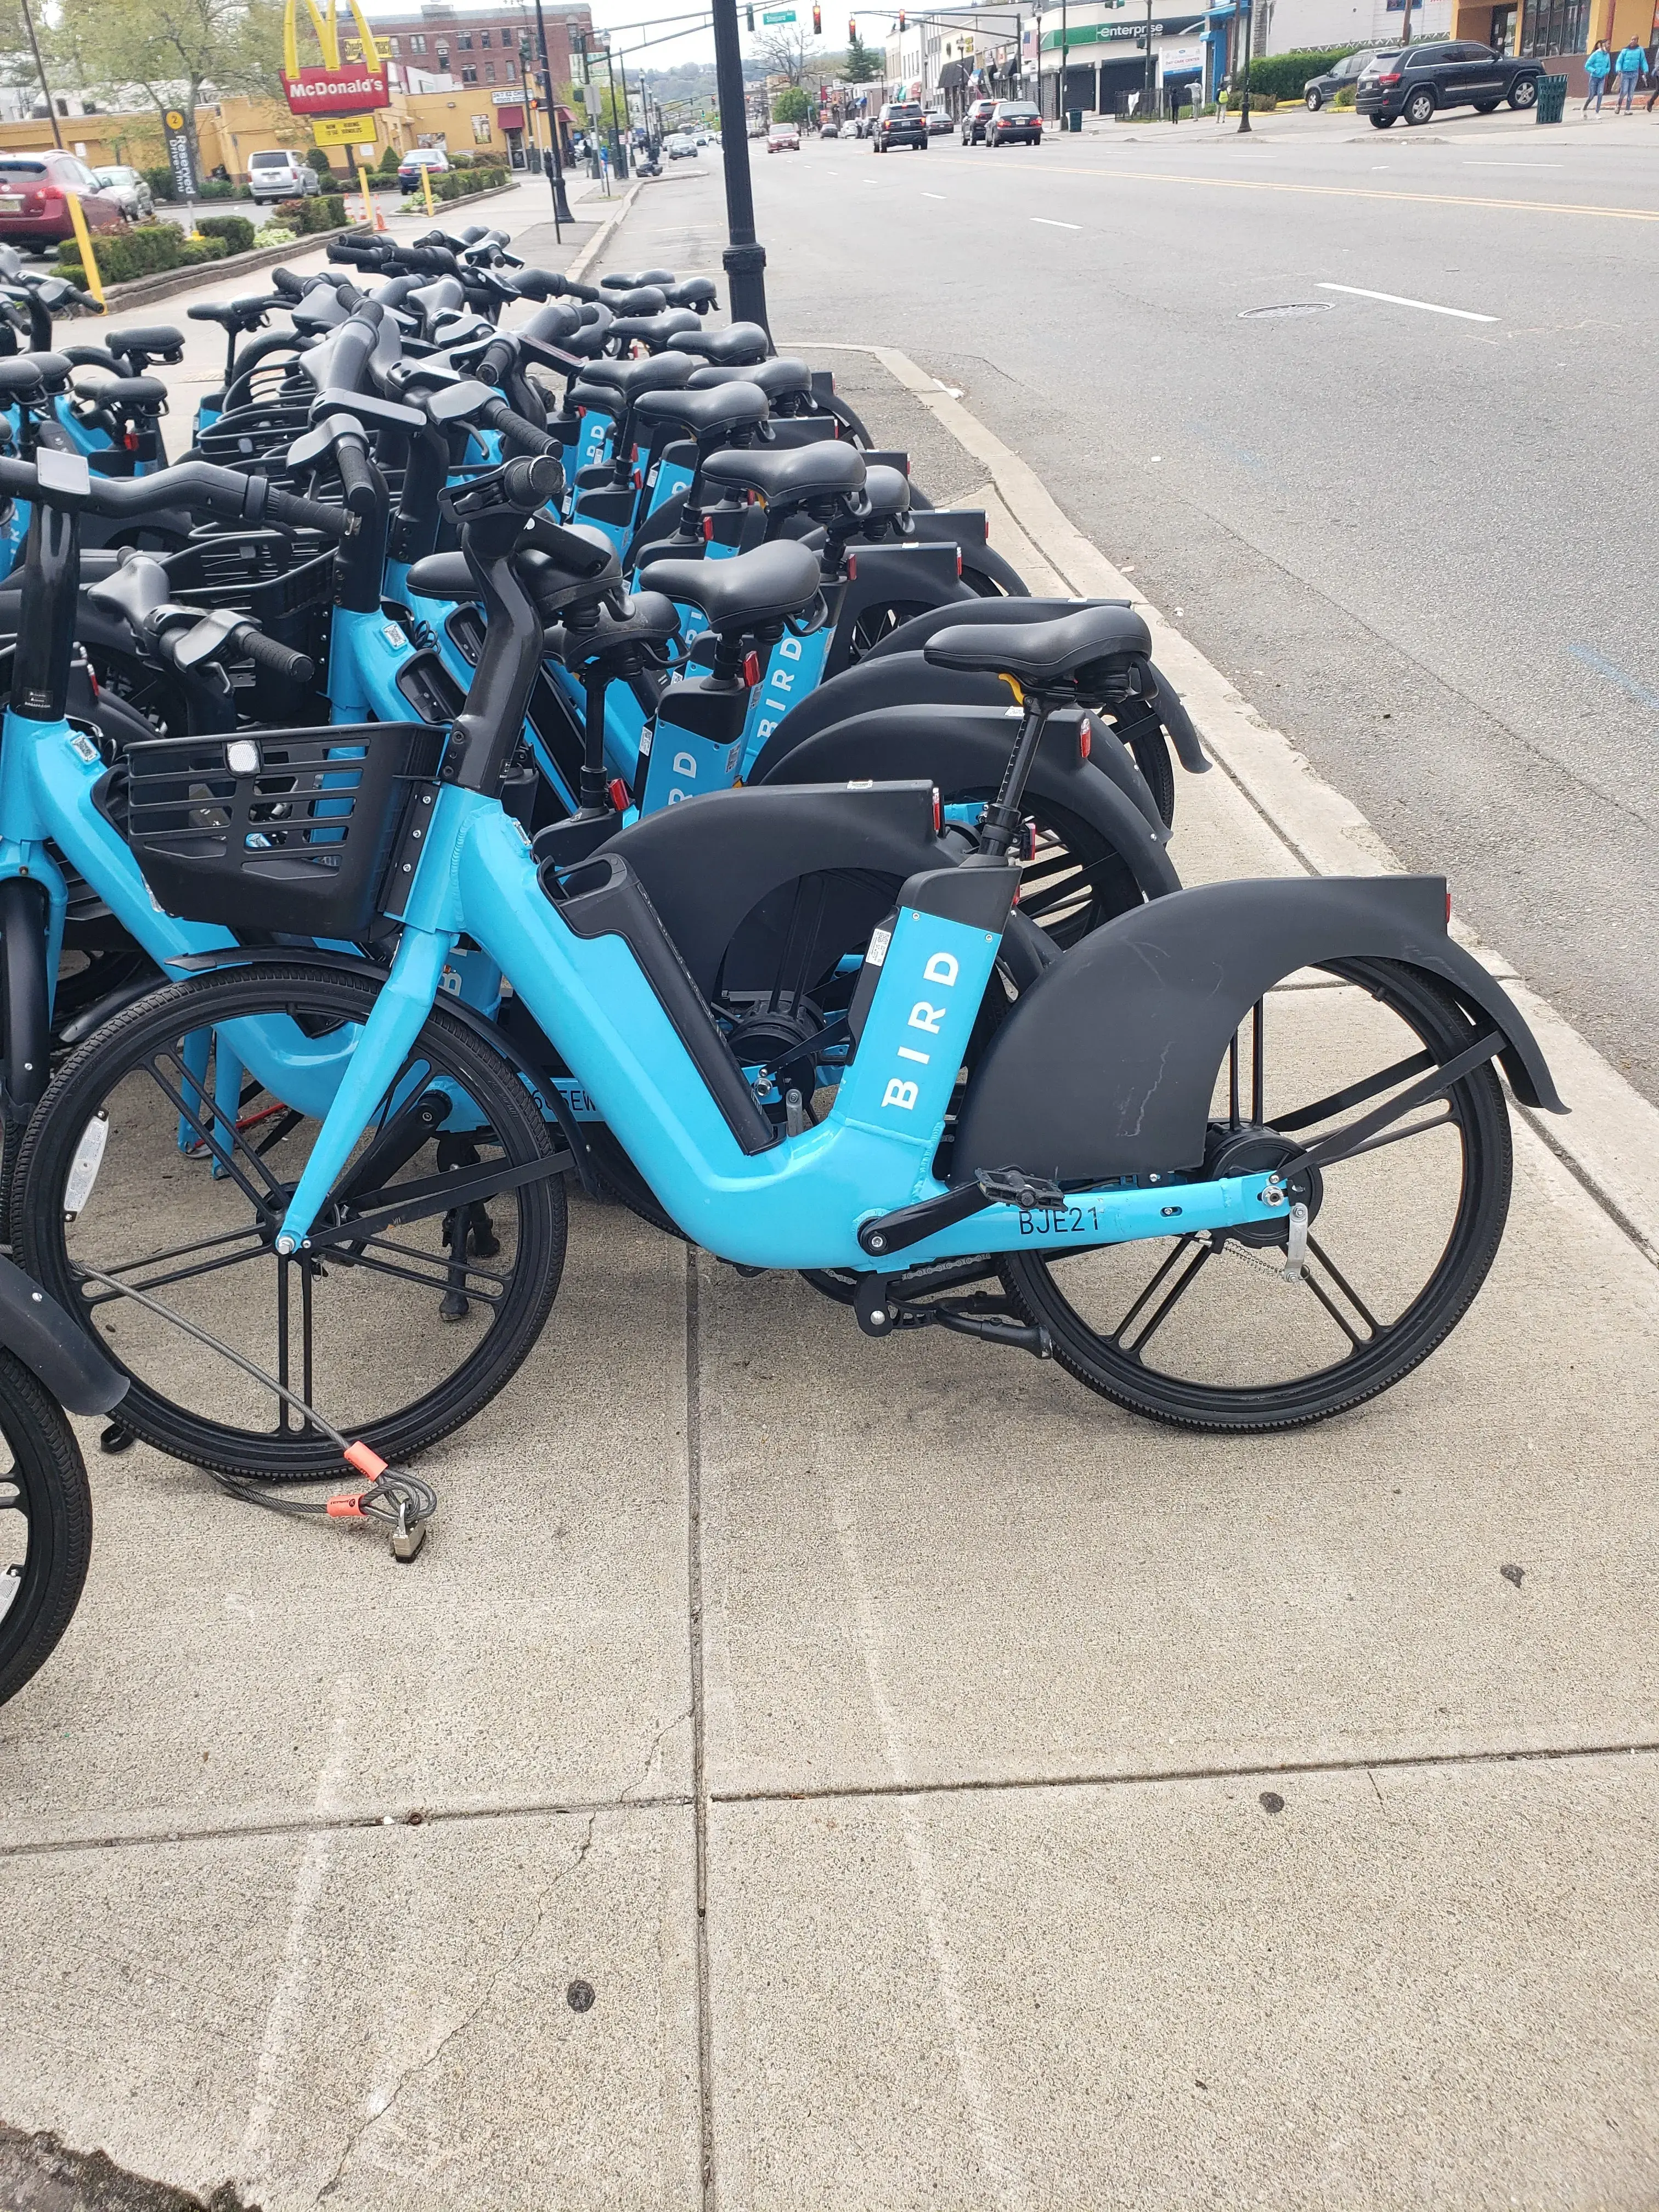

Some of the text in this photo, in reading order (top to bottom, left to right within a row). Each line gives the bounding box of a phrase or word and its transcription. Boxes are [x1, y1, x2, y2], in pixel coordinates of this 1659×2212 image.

[1098, 24, 1164, 37] enterprse
[290, 78, 383, 97] McDonald's
[171, 114, 179, 124] 2
[169, 139, 185, 192] Drive-Thru
[175, 135, 196, 194] Reserved
[757, 637, 802, 738] BIRD
[881, 952, 958, 1110] BIRD
[1018, 1206, 1098, 1235] BJE21
